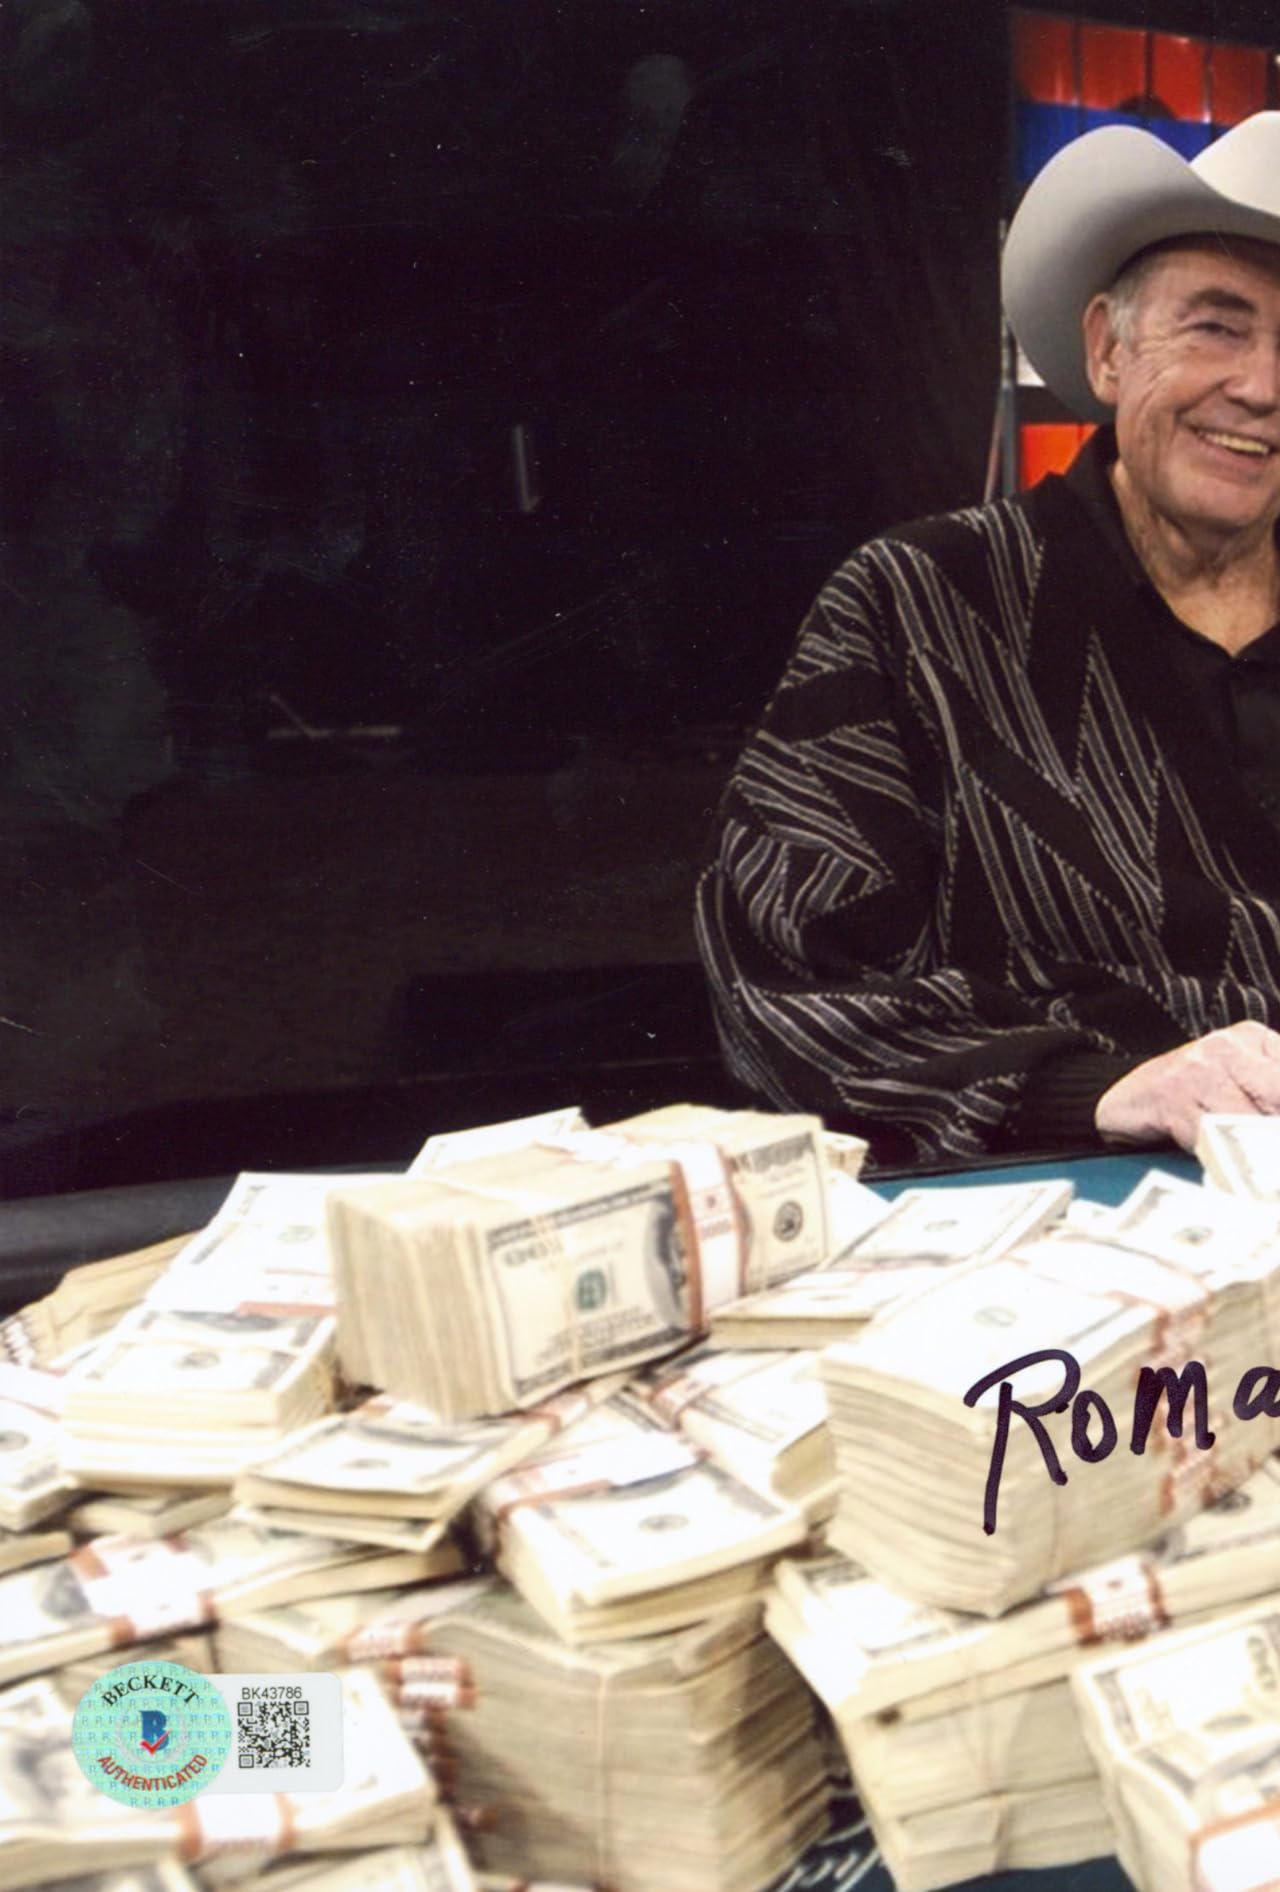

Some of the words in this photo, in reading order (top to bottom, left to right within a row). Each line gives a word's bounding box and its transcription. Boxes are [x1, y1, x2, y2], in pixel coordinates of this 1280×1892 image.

[101, 1674, 200, 1707] BECKETT
[241, 1686, 303, 1700] BK43786
[97, 1754, 208, 1792] AUTHENTICATED
